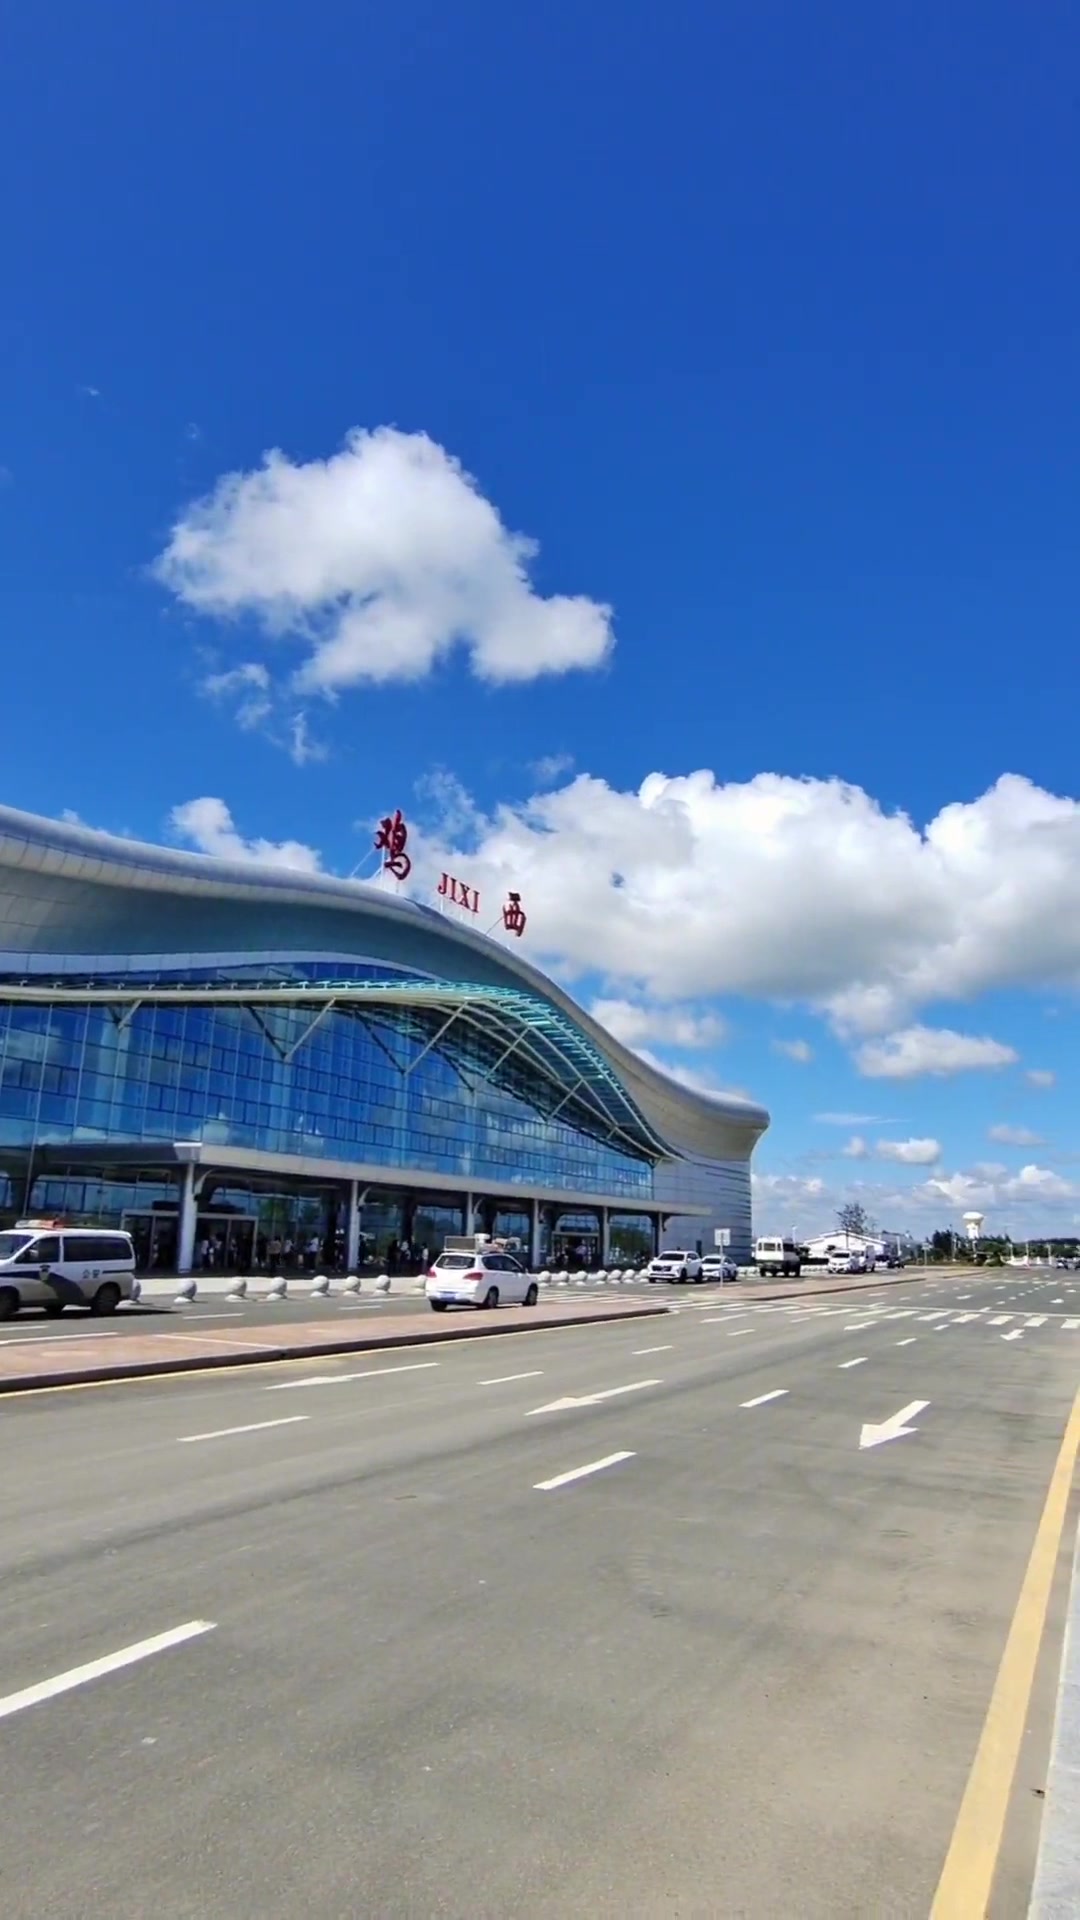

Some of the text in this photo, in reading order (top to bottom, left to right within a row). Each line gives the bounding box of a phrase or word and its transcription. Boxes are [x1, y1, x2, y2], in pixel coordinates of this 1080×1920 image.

[374, 809, 526, 937] 鸡 JIXI 西
